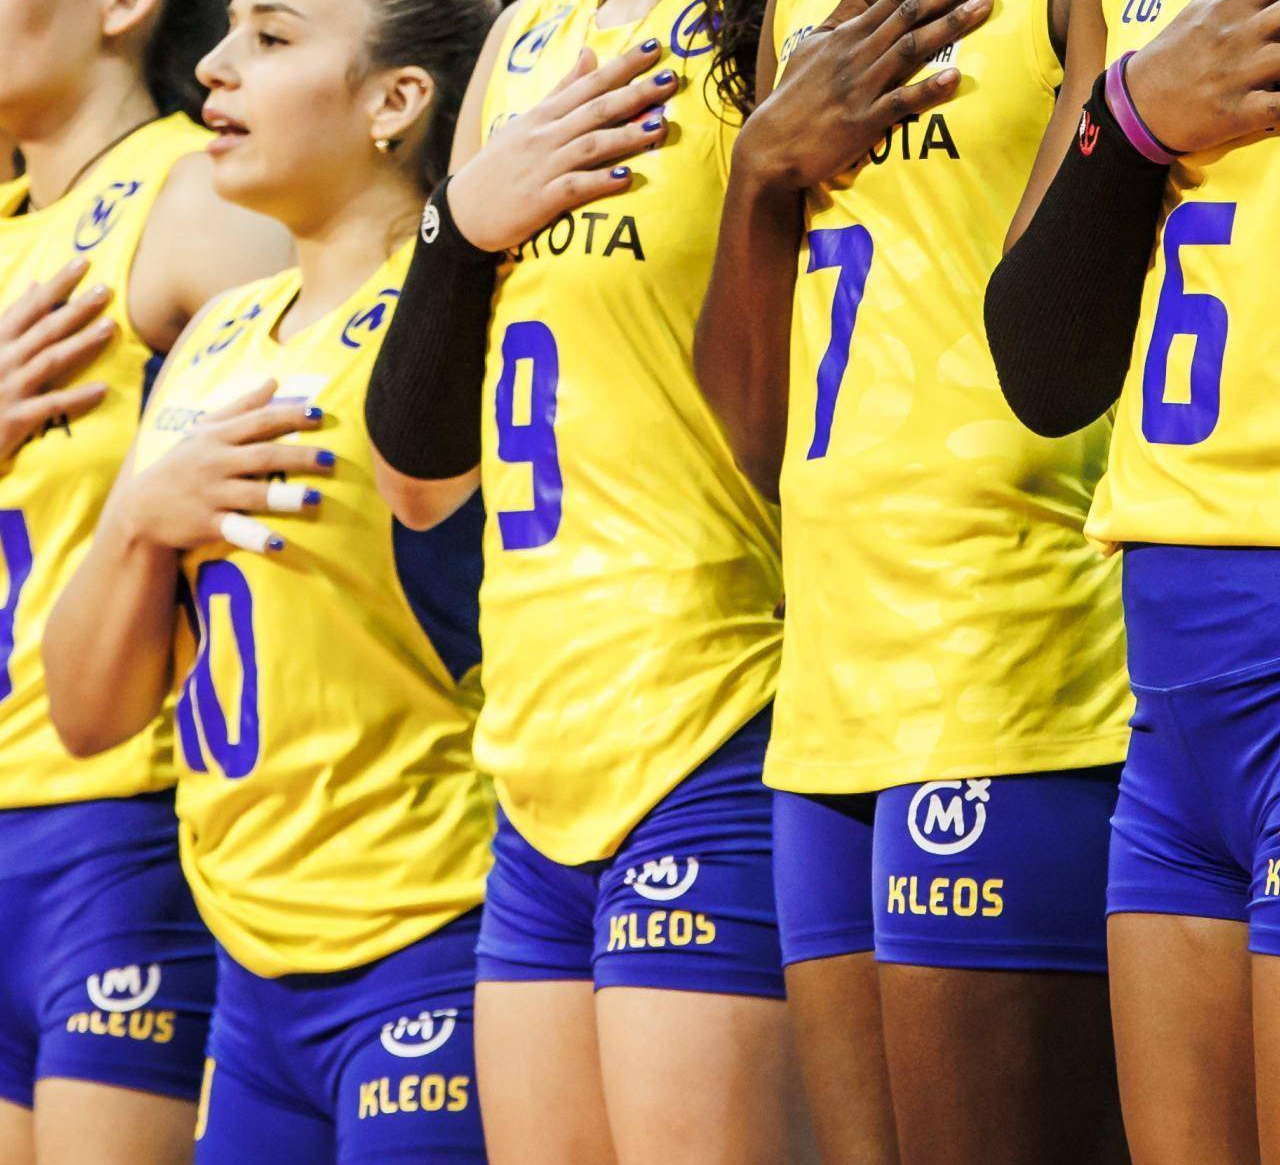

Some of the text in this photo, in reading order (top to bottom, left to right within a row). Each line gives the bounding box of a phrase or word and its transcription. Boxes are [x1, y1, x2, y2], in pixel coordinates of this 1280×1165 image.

[804, 223, 874, 462] 7
[1140, 201, 1237, 445] 6
[494, 320, 564, 552] 9
[606, 909, 716, 952] KLEOS
[887, 875, 1005, 917] KLEOS
[358, 1073, 471, 1119] KLEOS
